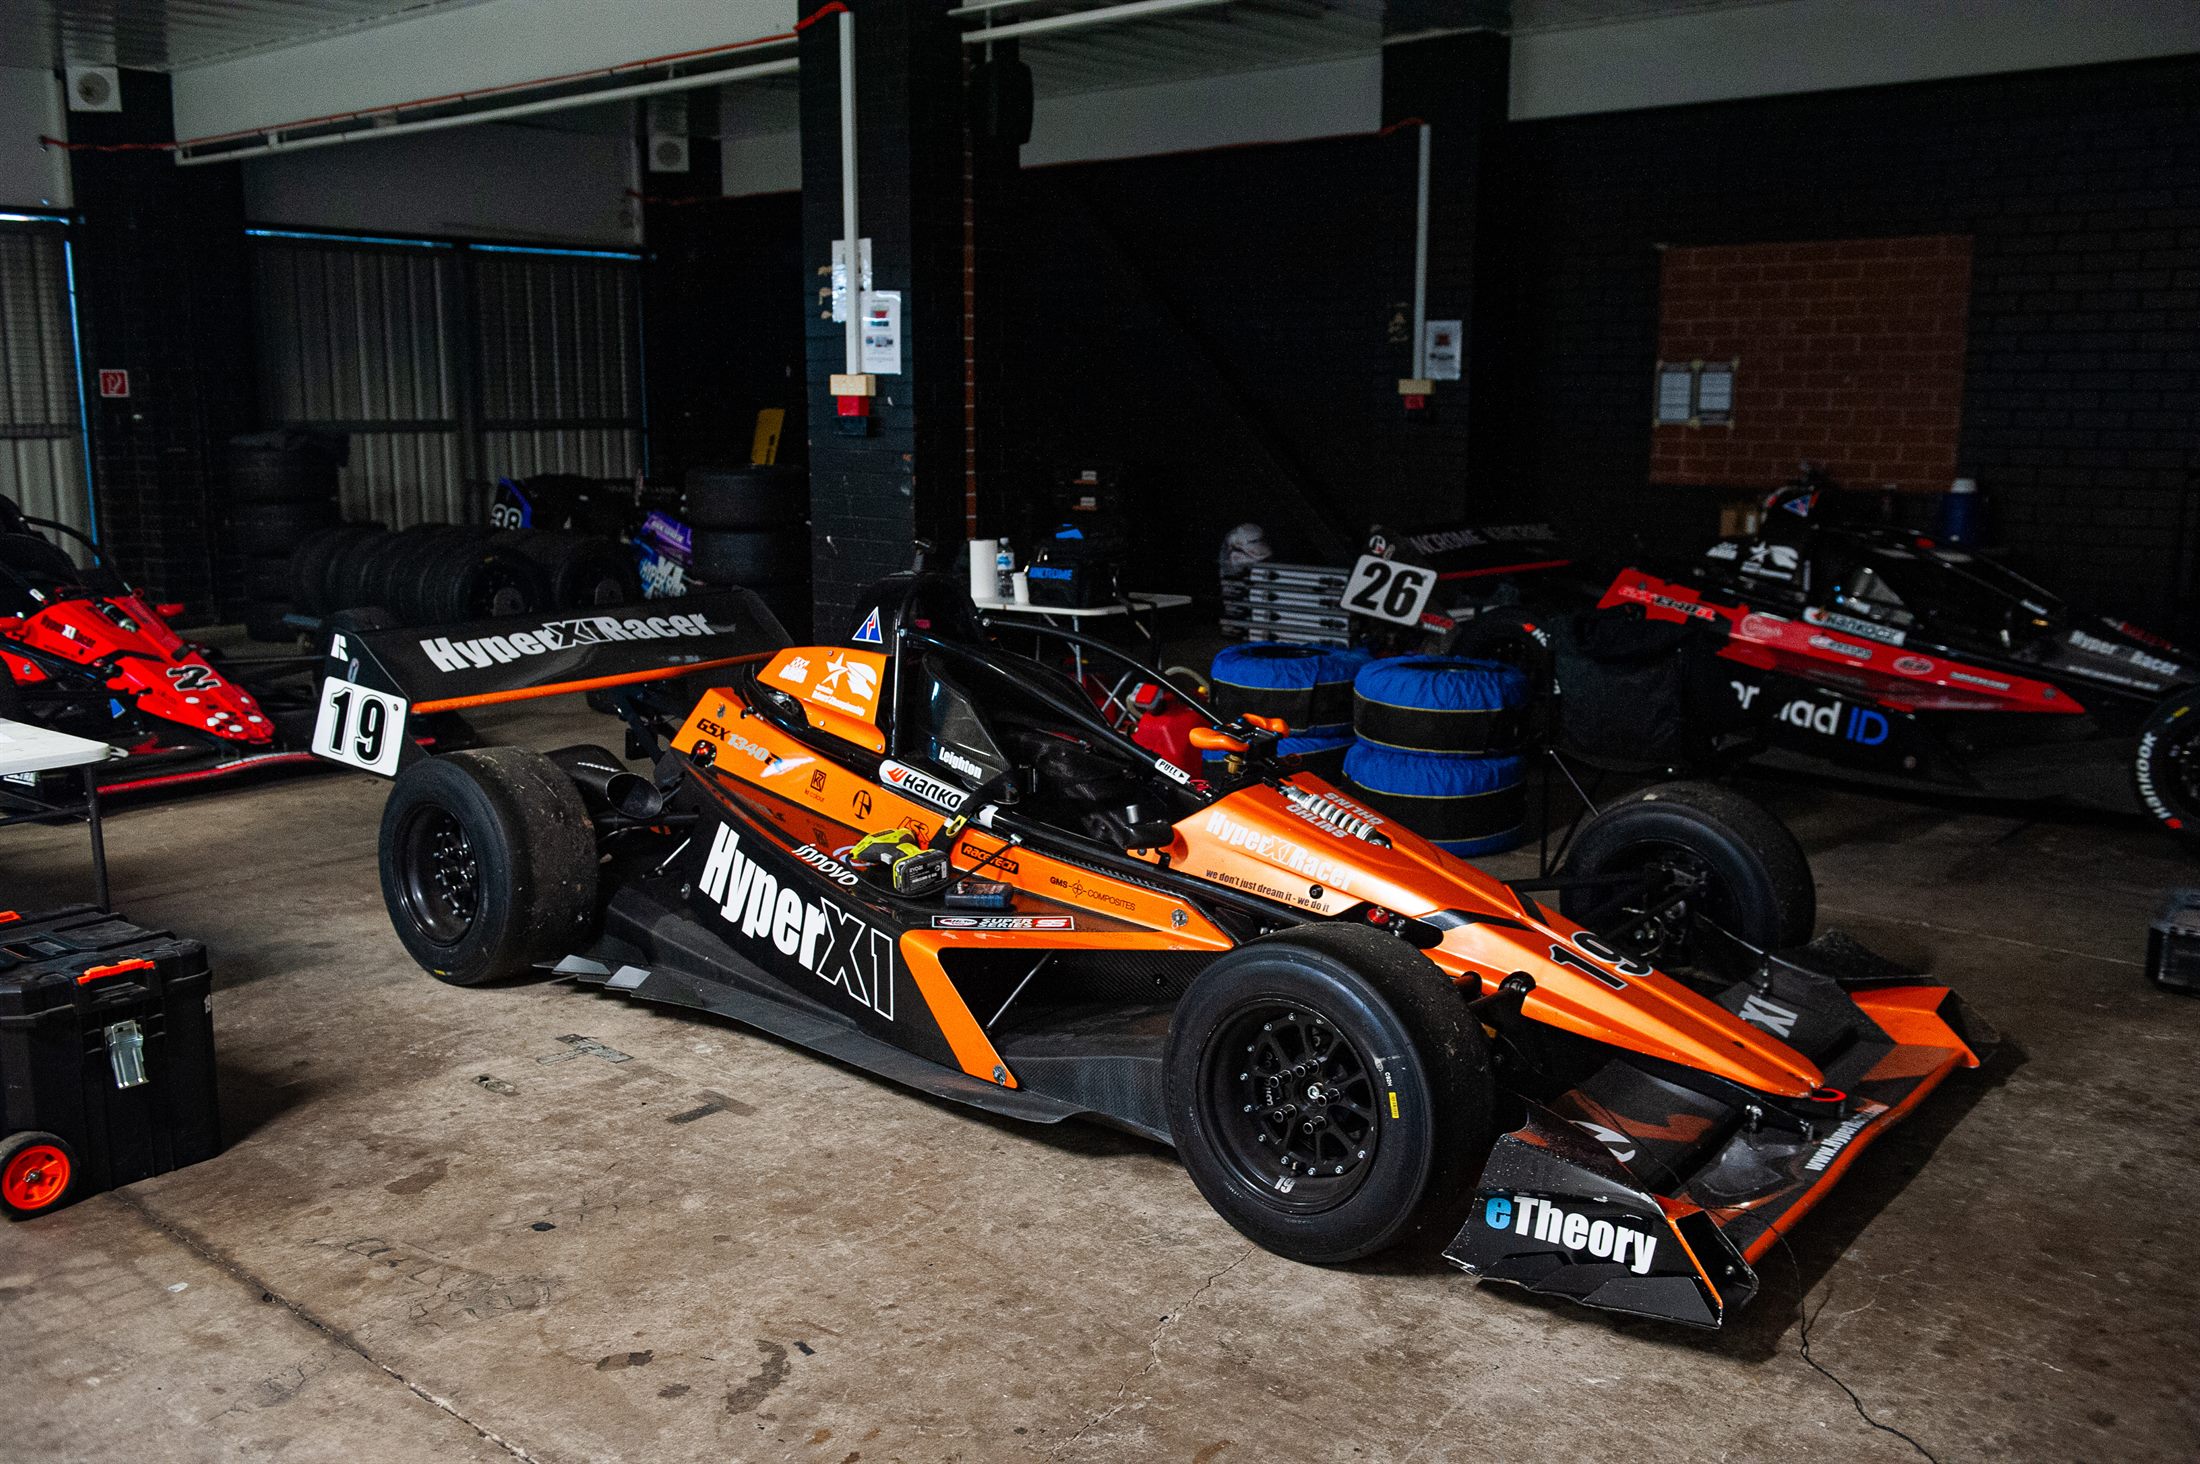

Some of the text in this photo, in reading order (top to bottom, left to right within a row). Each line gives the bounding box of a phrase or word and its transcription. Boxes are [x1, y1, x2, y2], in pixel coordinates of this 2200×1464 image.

[1351, 562, 1423, 617] 26
[328, 685, 389, 767] 19
[697, 717, 731, 741] GSX
[1846, 706, 1889, 747] ID
[938, 746, 983, 780] Leighton
[1158, 760, 1178, 776] PULL
[791, 843, 859, 886] innovo
[1049, 876, 1137, 912] GMS COMPOSITES
[1205, 869, 1218, 880] we
[1240, 878, 1257, 892] just
[1257, 882, 1285, 901] dream
[1297, 896, 1310, 907] we
[1310, 898, 1322, 910] do
[1274, 1175, 1297, 1194] 19
[1484, 1194, 1658, 1275] eTheory
